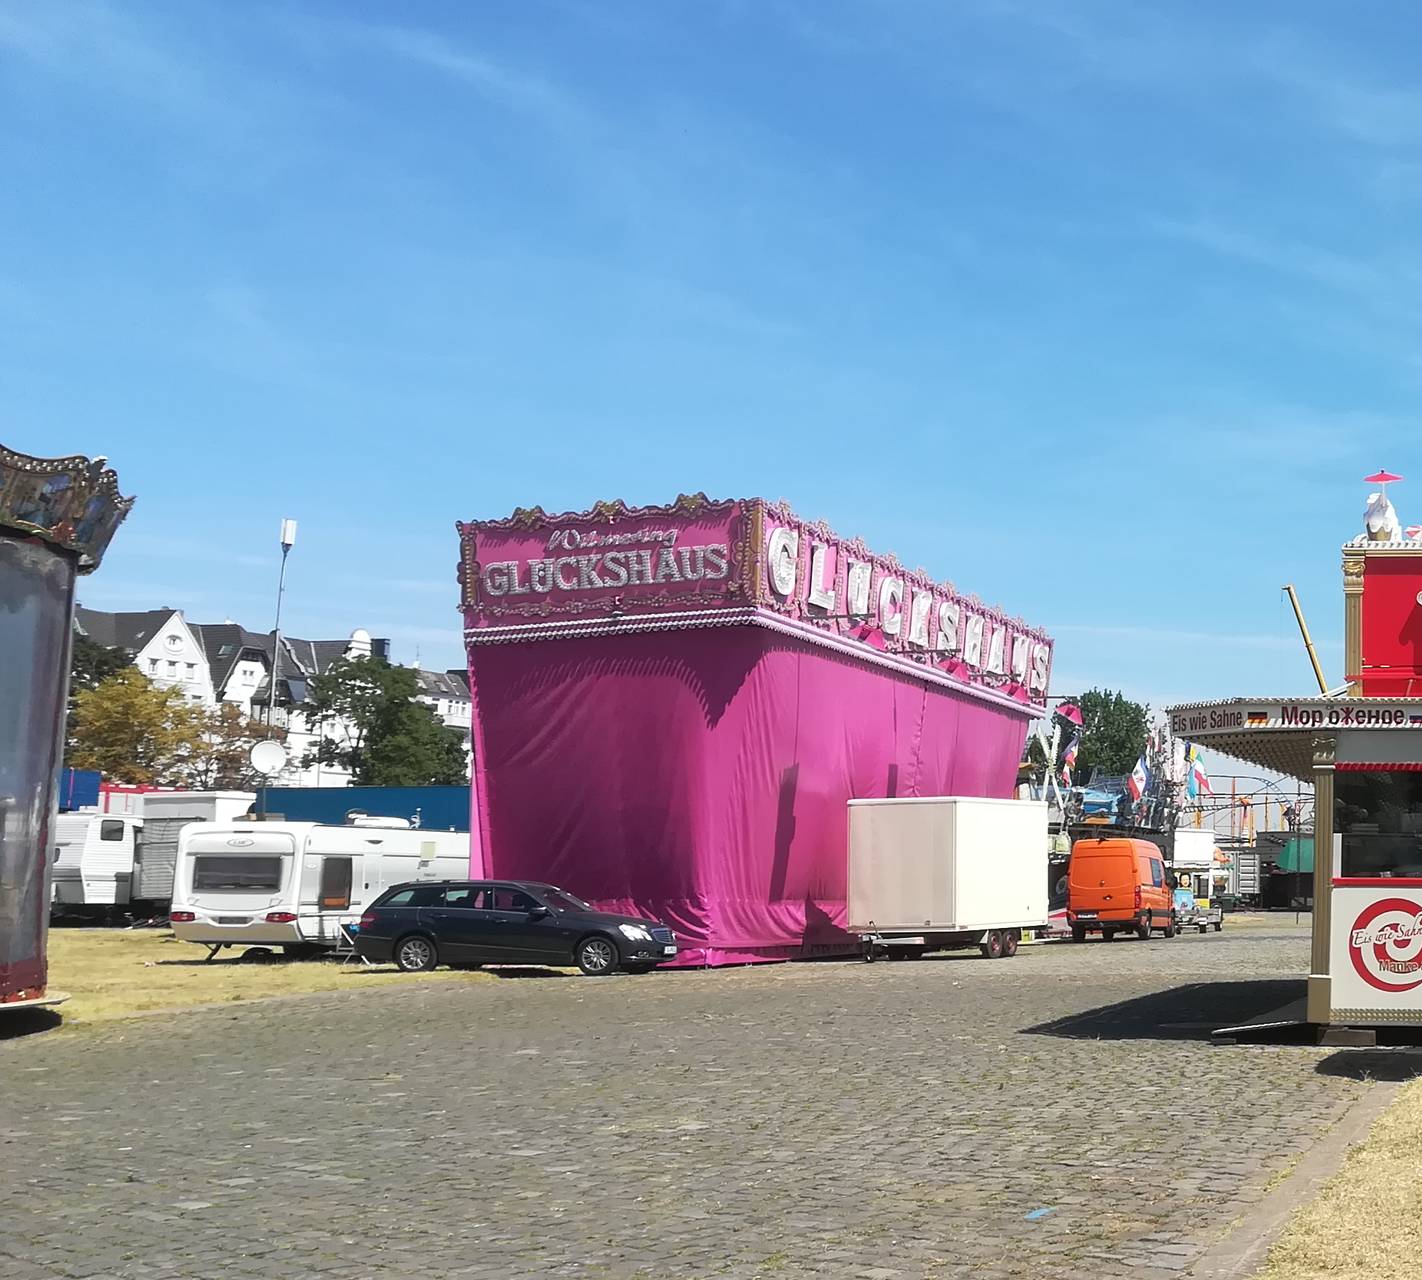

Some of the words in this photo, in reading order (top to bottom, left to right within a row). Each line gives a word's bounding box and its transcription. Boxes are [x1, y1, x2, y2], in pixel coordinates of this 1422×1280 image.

[1172, 714, 1187, 732] Eis
[1189, 712, 1208, 731] wie
[1210, 709, 1243, 728] Sahne
[1354, 930, 1372, 946] Eis
[1375, 926, 1395, 943] wie
[1378, 959, 1419, 973] Manke
